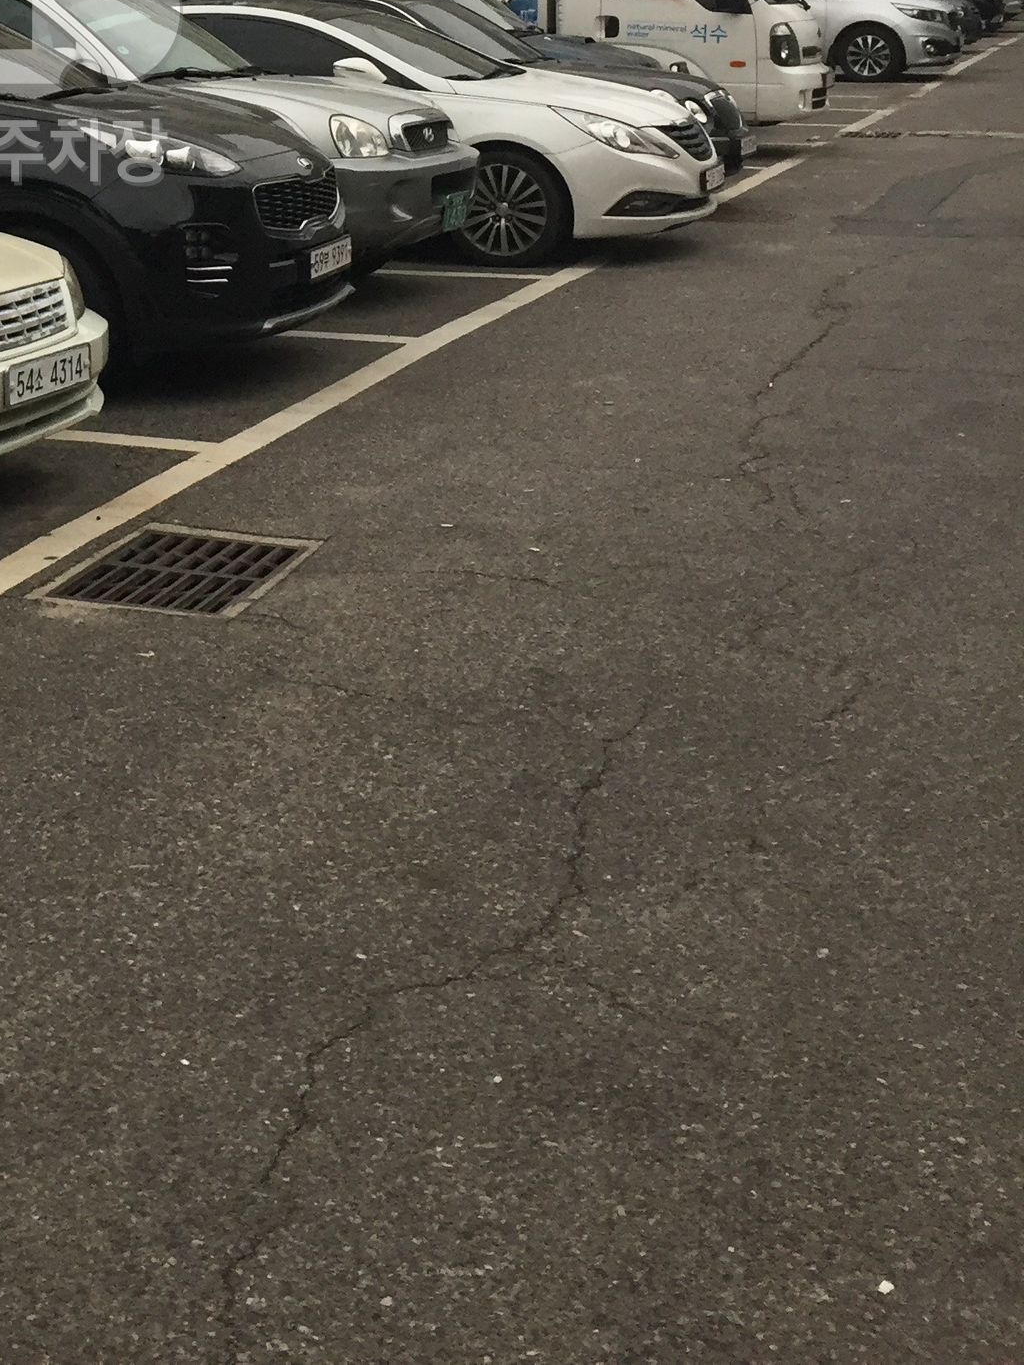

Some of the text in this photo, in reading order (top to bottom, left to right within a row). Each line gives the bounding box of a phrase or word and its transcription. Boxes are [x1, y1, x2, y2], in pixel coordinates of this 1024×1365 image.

[690, 24, 729, 44] 석수
[16, 353, 83, 398] 54소 4314
